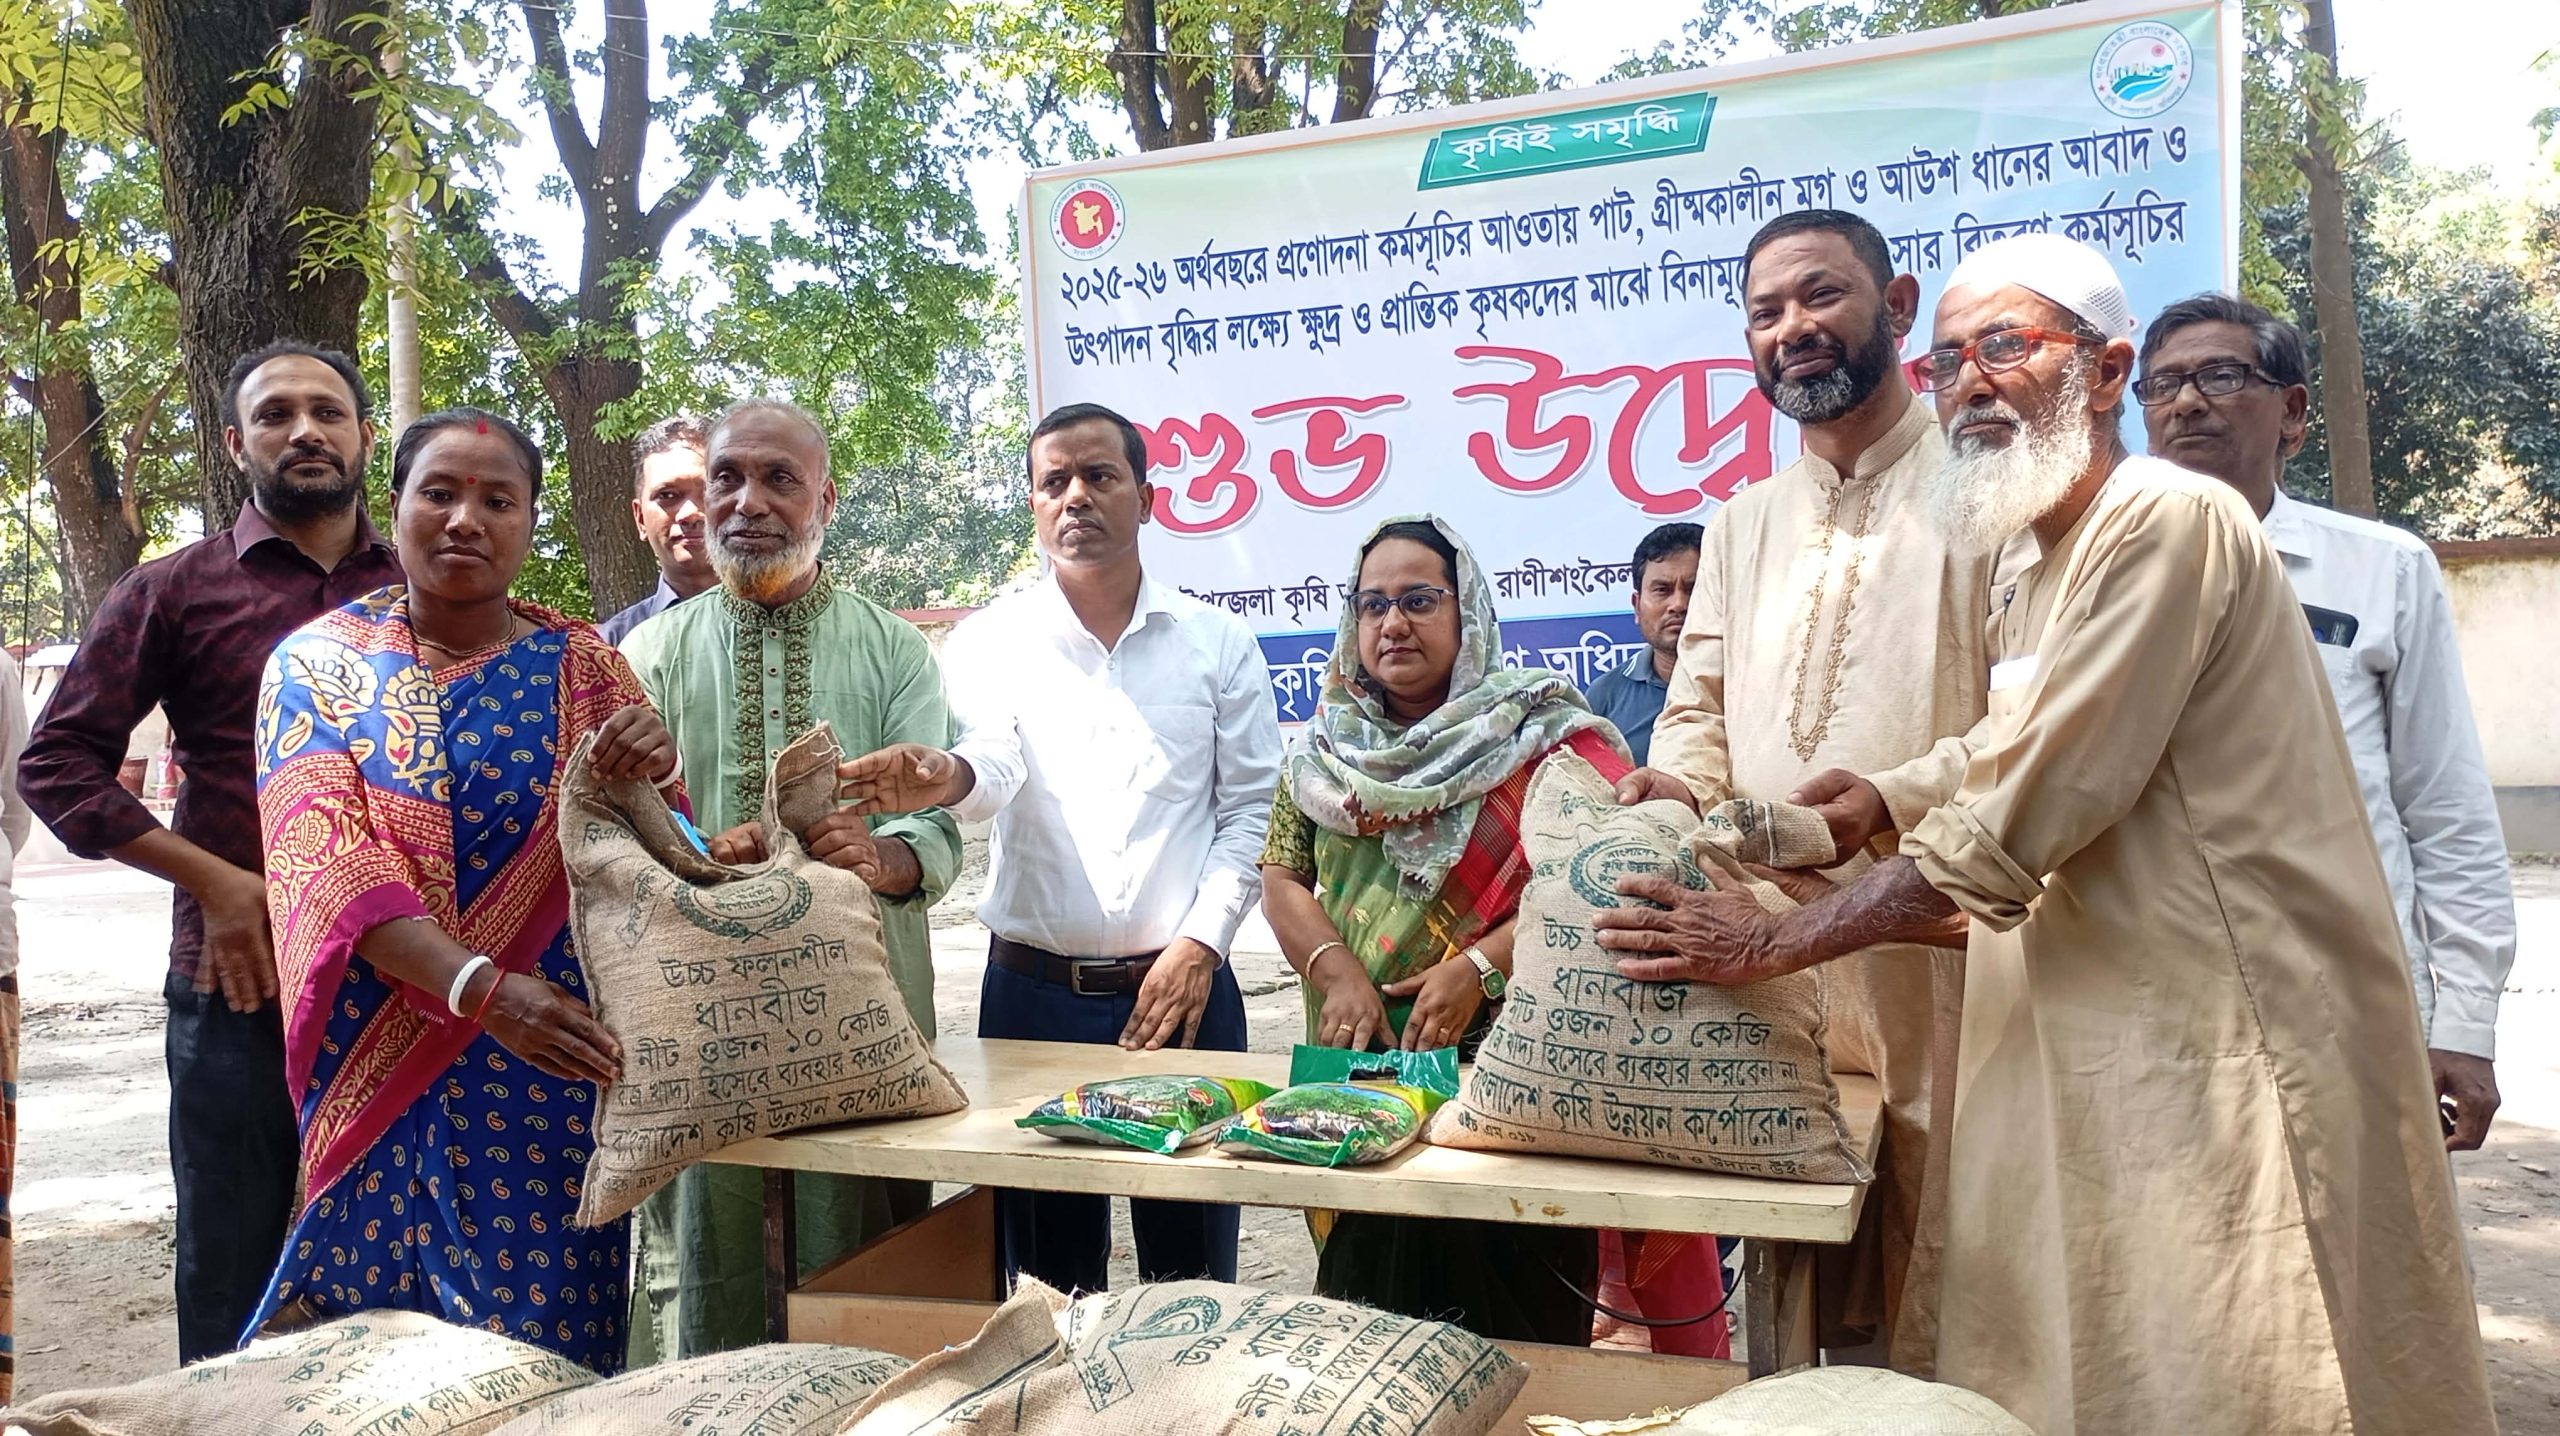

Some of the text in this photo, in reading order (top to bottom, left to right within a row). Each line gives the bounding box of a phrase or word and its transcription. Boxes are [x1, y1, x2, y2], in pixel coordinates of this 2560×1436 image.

[1451, 105, 1685, 171] কৃষিই সমৃদ্ধি
[1061, 261, 1167, 310] ২০২৫-২৬
[1174, 239, 1269, 292] অর্থবছরে
[1276, 229, 1369, 281] প্রণোদনা
[1375, 210, 1473, 275] কর্মসূচির
[1479, 203, 1580, 254] আওতায়
[1589, 187, 1644, 246] পাট,
[1651, 166, 1785, 234] গ্রীষ্মকালীন
[1846, 169, 1868, 204] ও
[1876, 146, 1960, 203] আউশ
[1972, 142, 2053, 194] ধানের
[2061, 125, 2153, 178] আবাদ
[2163, 126, 2187, 164] ও
[1065, 323, 1153, 366] উৎপাদন
[1158, 308, 1219, 373] বৃদ্ধির
[1226, 310, 1292, 351] লক্ষ্যে
[1297, 304, 1342, 355] ক্ষুদ্র
[1351, 302, 1370, 335] ও
[1380, 281, 1461, 336] প্রান্তিক
[1467, 276, 1579, 341] কৃষকদের
[1586, 262, 1652, 311] মাঝে
[2060, 189, 2187, 263] কর্মসূচির
[1134, 394, 1406, 534] শুভ
[1179, 585, 1275, 617] পজেলা
[1281, 576, 1330, 626] কৃষি
[658, 934, 849, 987] উচ্চ ফলনশীল
[1542, 913, 1585, 950] উচ্চ
[636, 1000, 892, 1071] নীট ওজন ১০ কেজি
[696, 977, 827, 1034] ধানবীজ
[1509, 986, 1538, 1023] নীট
[1546, 1007, 1614, 1039] ওজন
[1629, 1017, 1673, 1045] ১০
[1691, 1013, 1772, 1049] কেজি
[700, 1066, 770, 1101] হিসেবে
[777, 1052, 844, 1087] ব্যবহার
[1541, 1031, 1608, 1078] হিসেবে
[1616, 1053, 1691, 1088] ব্যবহার
[1700, 1058, 1774, 1087] করবেন
[1779, 1061, 1800, 1081] না
[612, 1119, 705, 1161] বাংলাদেশ
[713, 1100, 758, 1147] কৃষি
[1470, 1065, 1810, 1147] বাংলাদেশ কৃষি উন্নয়ন কর্পোরেশন
[1320, 1313, 1358, 1333] ১০
